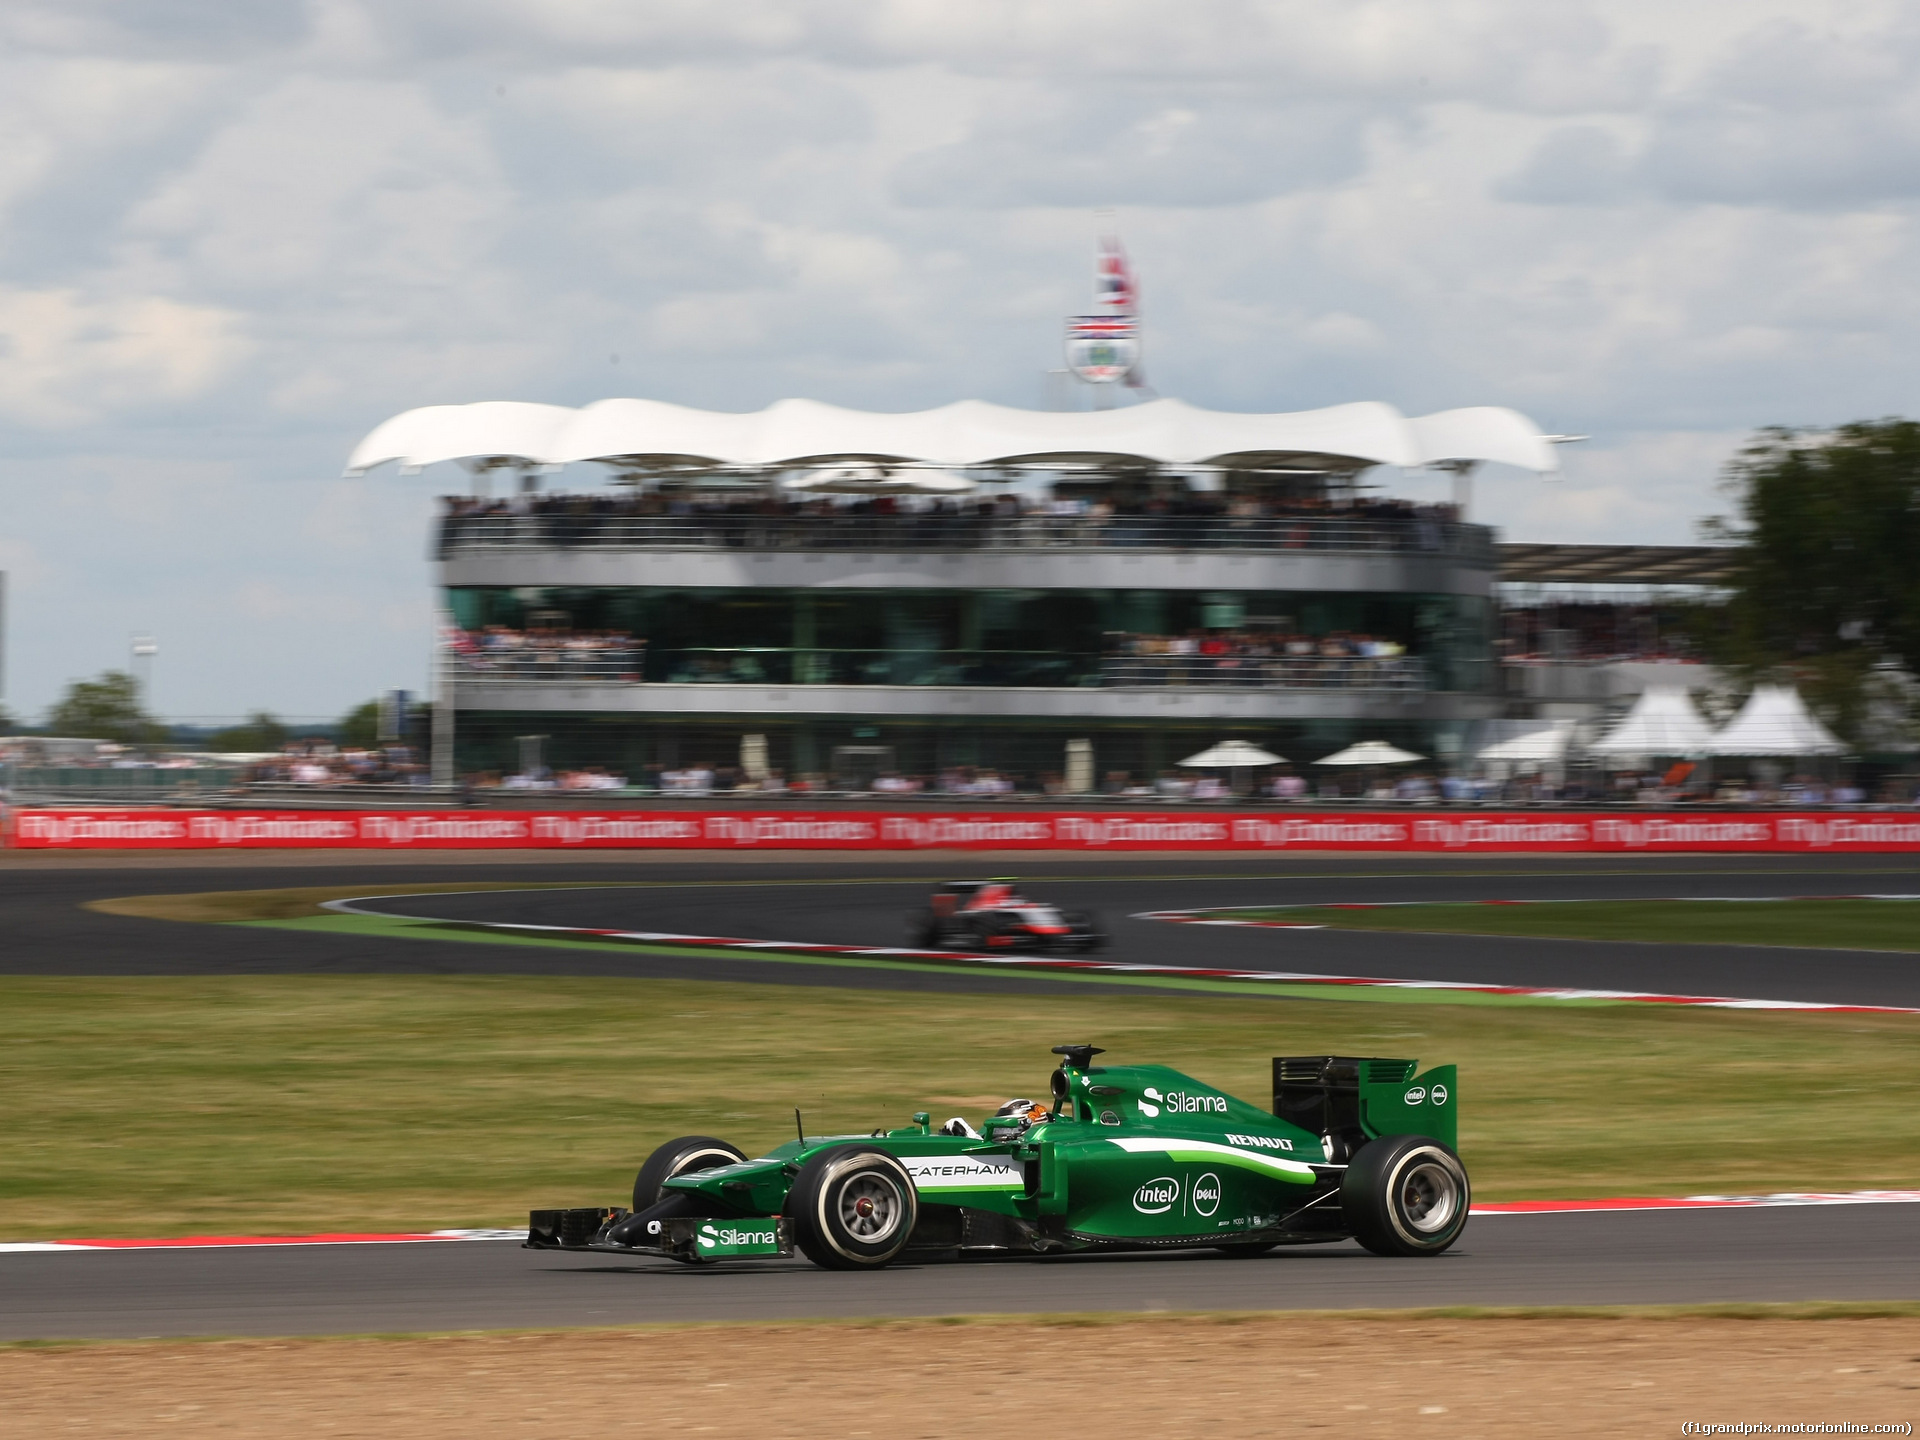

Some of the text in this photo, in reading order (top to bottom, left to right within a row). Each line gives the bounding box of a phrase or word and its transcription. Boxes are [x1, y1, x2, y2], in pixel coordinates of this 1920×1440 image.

[1166, 1091, 1227, 1113] Silanna
[1224, 1133, 1293, 1151] RENAULT
[907, 1165, 1010, 1177] CATERHAM
[1140, 1185, 1172, 1203] intel
[1196, 1189, 1218, 1200] DELL
[719, 1229, 775, 1246] Silanna
